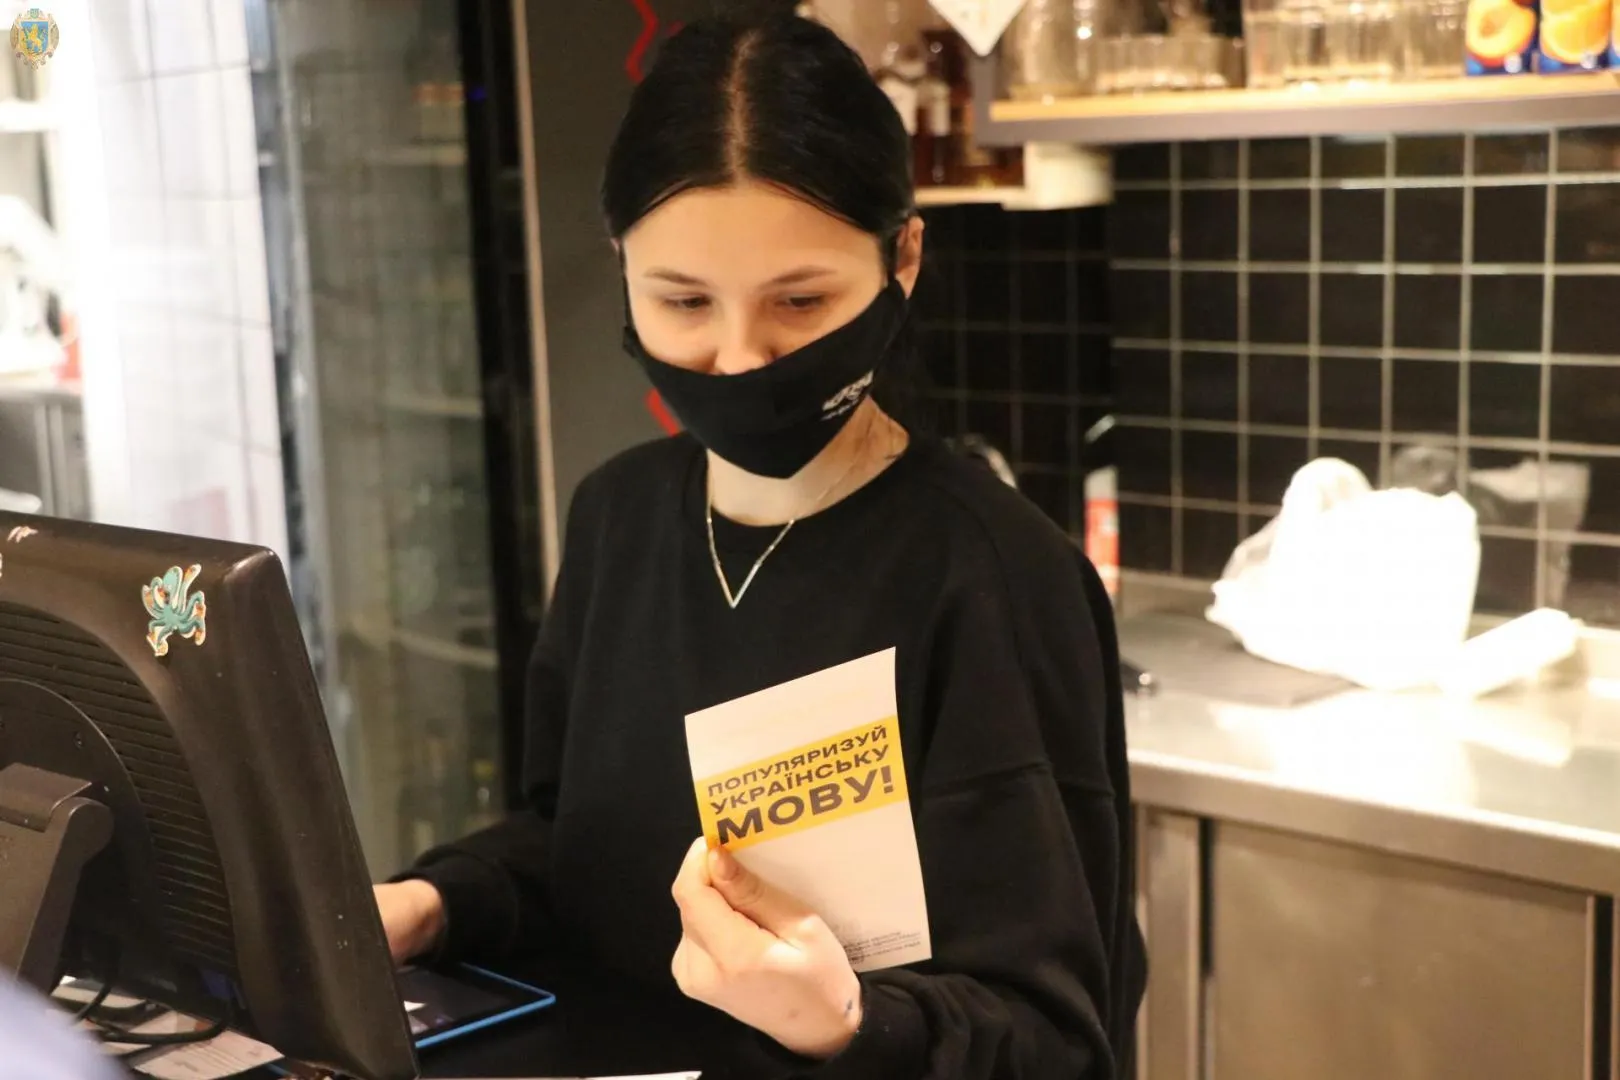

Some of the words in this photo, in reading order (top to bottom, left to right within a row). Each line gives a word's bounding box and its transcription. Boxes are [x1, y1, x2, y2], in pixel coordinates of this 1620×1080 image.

[707, 725, 887, 797] ПОПУЛЯРИЗУЙ
[710, 744, 889, 815] УКРАЇНСЬКУ
[716, 765, 894, 845] МОВУ!
